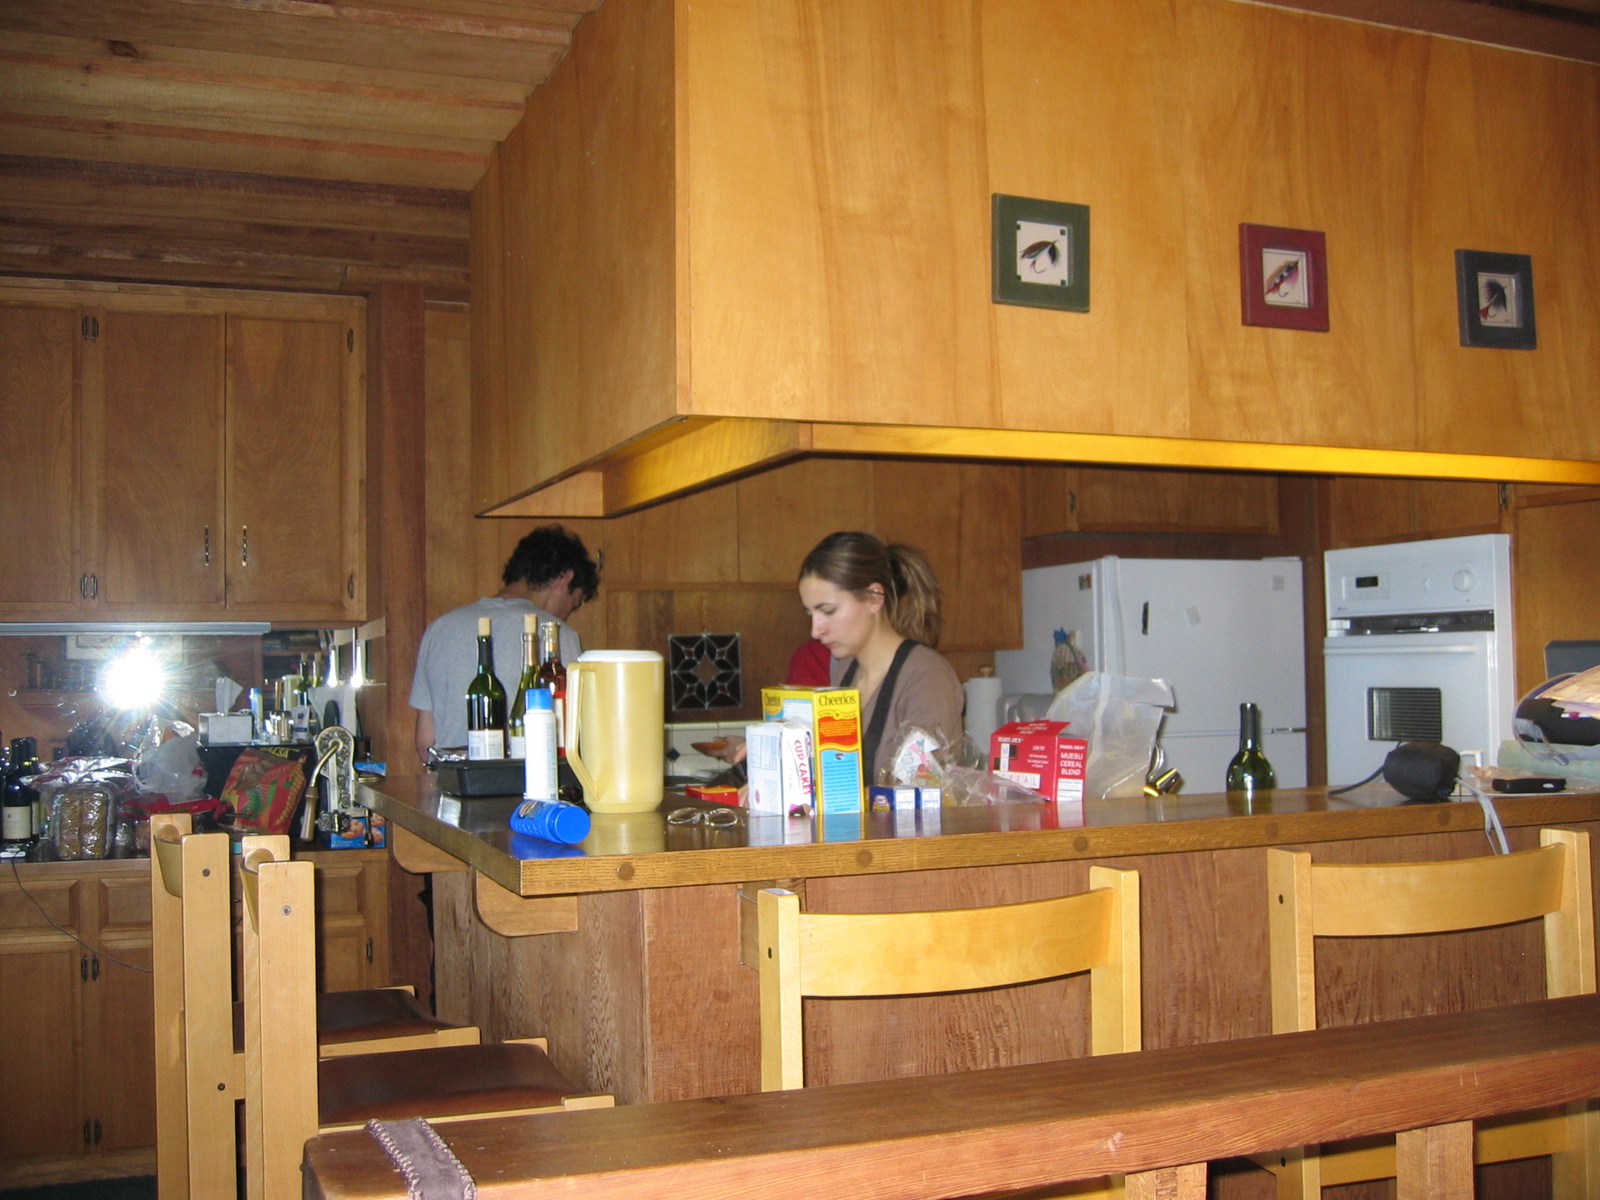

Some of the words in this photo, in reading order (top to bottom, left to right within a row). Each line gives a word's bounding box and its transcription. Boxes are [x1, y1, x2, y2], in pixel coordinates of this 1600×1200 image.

[818, 693, 856, 707] Cheerios
[794, 739, 805, 760] CUP
[1060, 752, 1083, 760] MUESLI
[1059, 760, 1082, 768] CEREAL
[1060, 768, 1081, 776] BLEND
